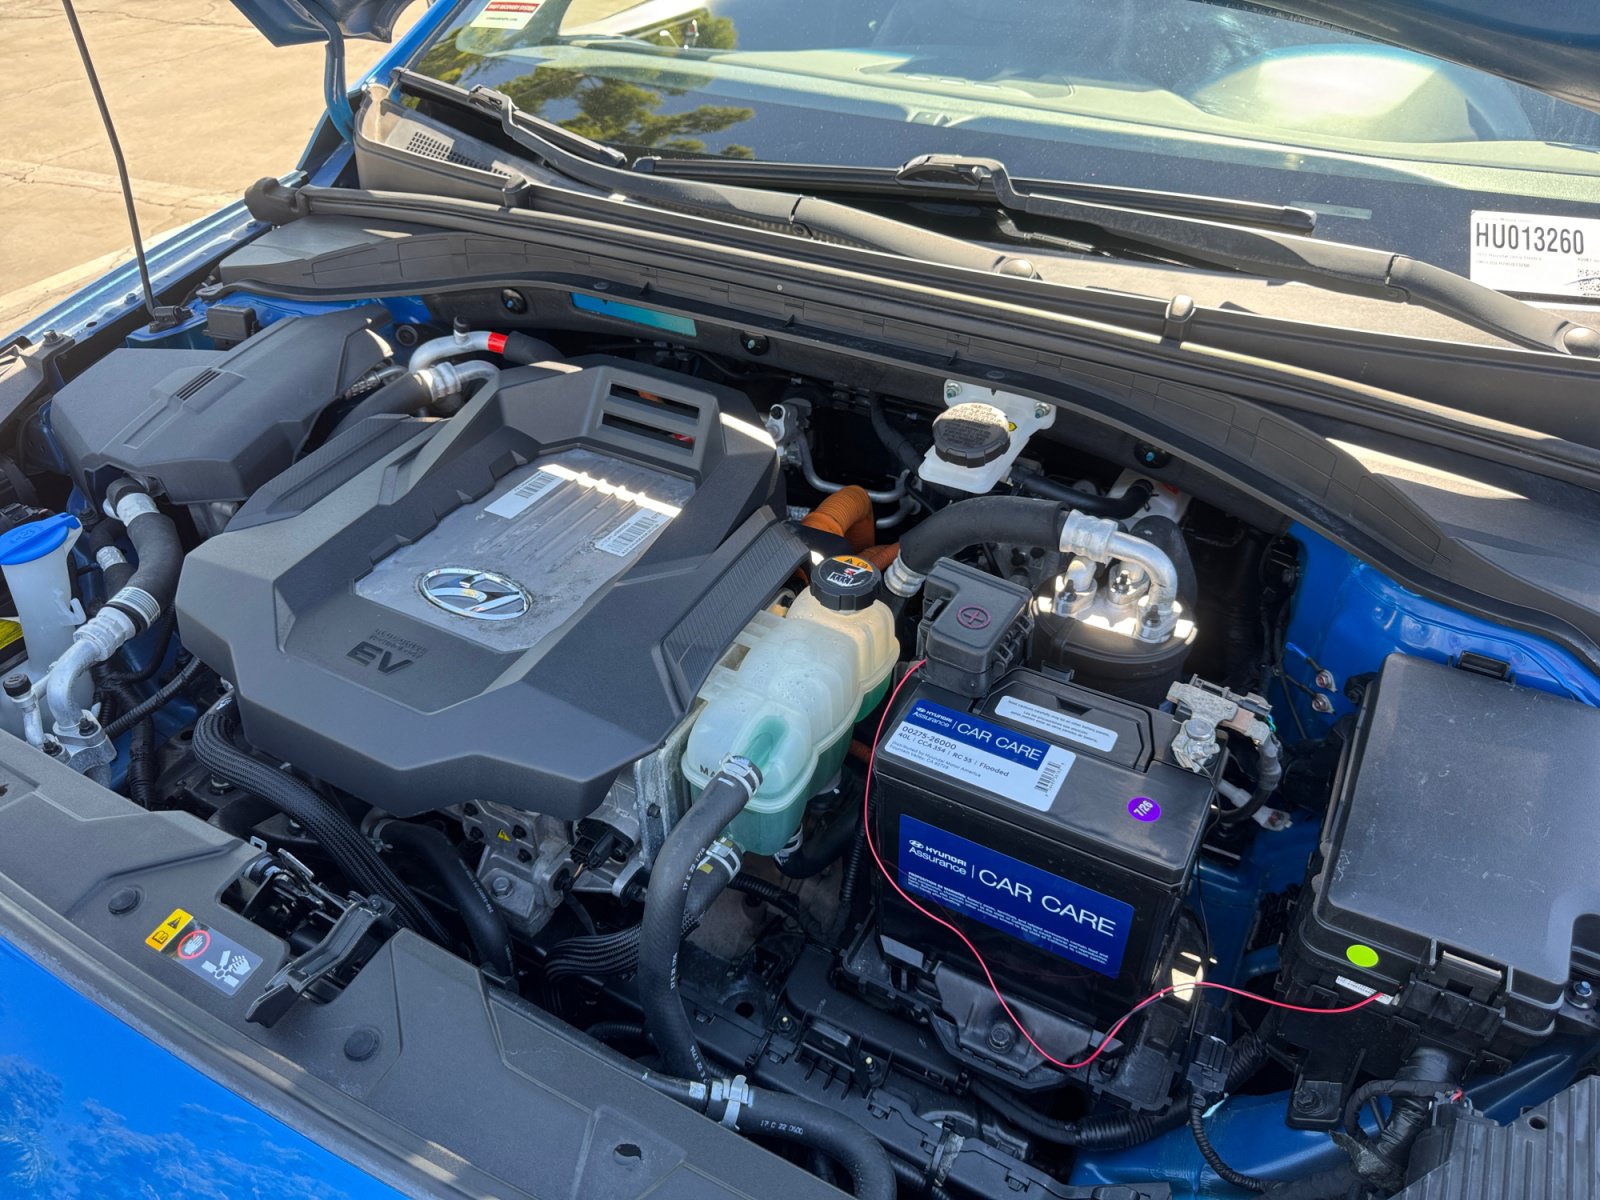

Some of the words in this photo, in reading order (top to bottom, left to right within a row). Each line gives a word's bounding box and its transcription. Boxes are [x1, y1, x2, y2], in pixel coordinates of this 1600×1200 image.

[1476, 222, 1584, 255] HU013260
[346, 641, 412, 674] EV
[912, 711, 950, 728] Assurance
[902, 725, 957, 751] 00275-26000
[957, 723, 993, 743] CAR
[995, 736, 1043, 762] CARE
[898, 732, 911, 741] 40L
[917, 739, 932, 749] CCA
[952, 752, 964, 760] RC
[979, 761, 1010, 777] Flooded
[1133, 800, 1153, 817] 7/26
[908, 847, 967, 876] Assurance
[925, 845, 967, 867] HYUNDAI
[978, 868, 1032, 903] CAR
[1041, 895, 1117, 937] CARE
